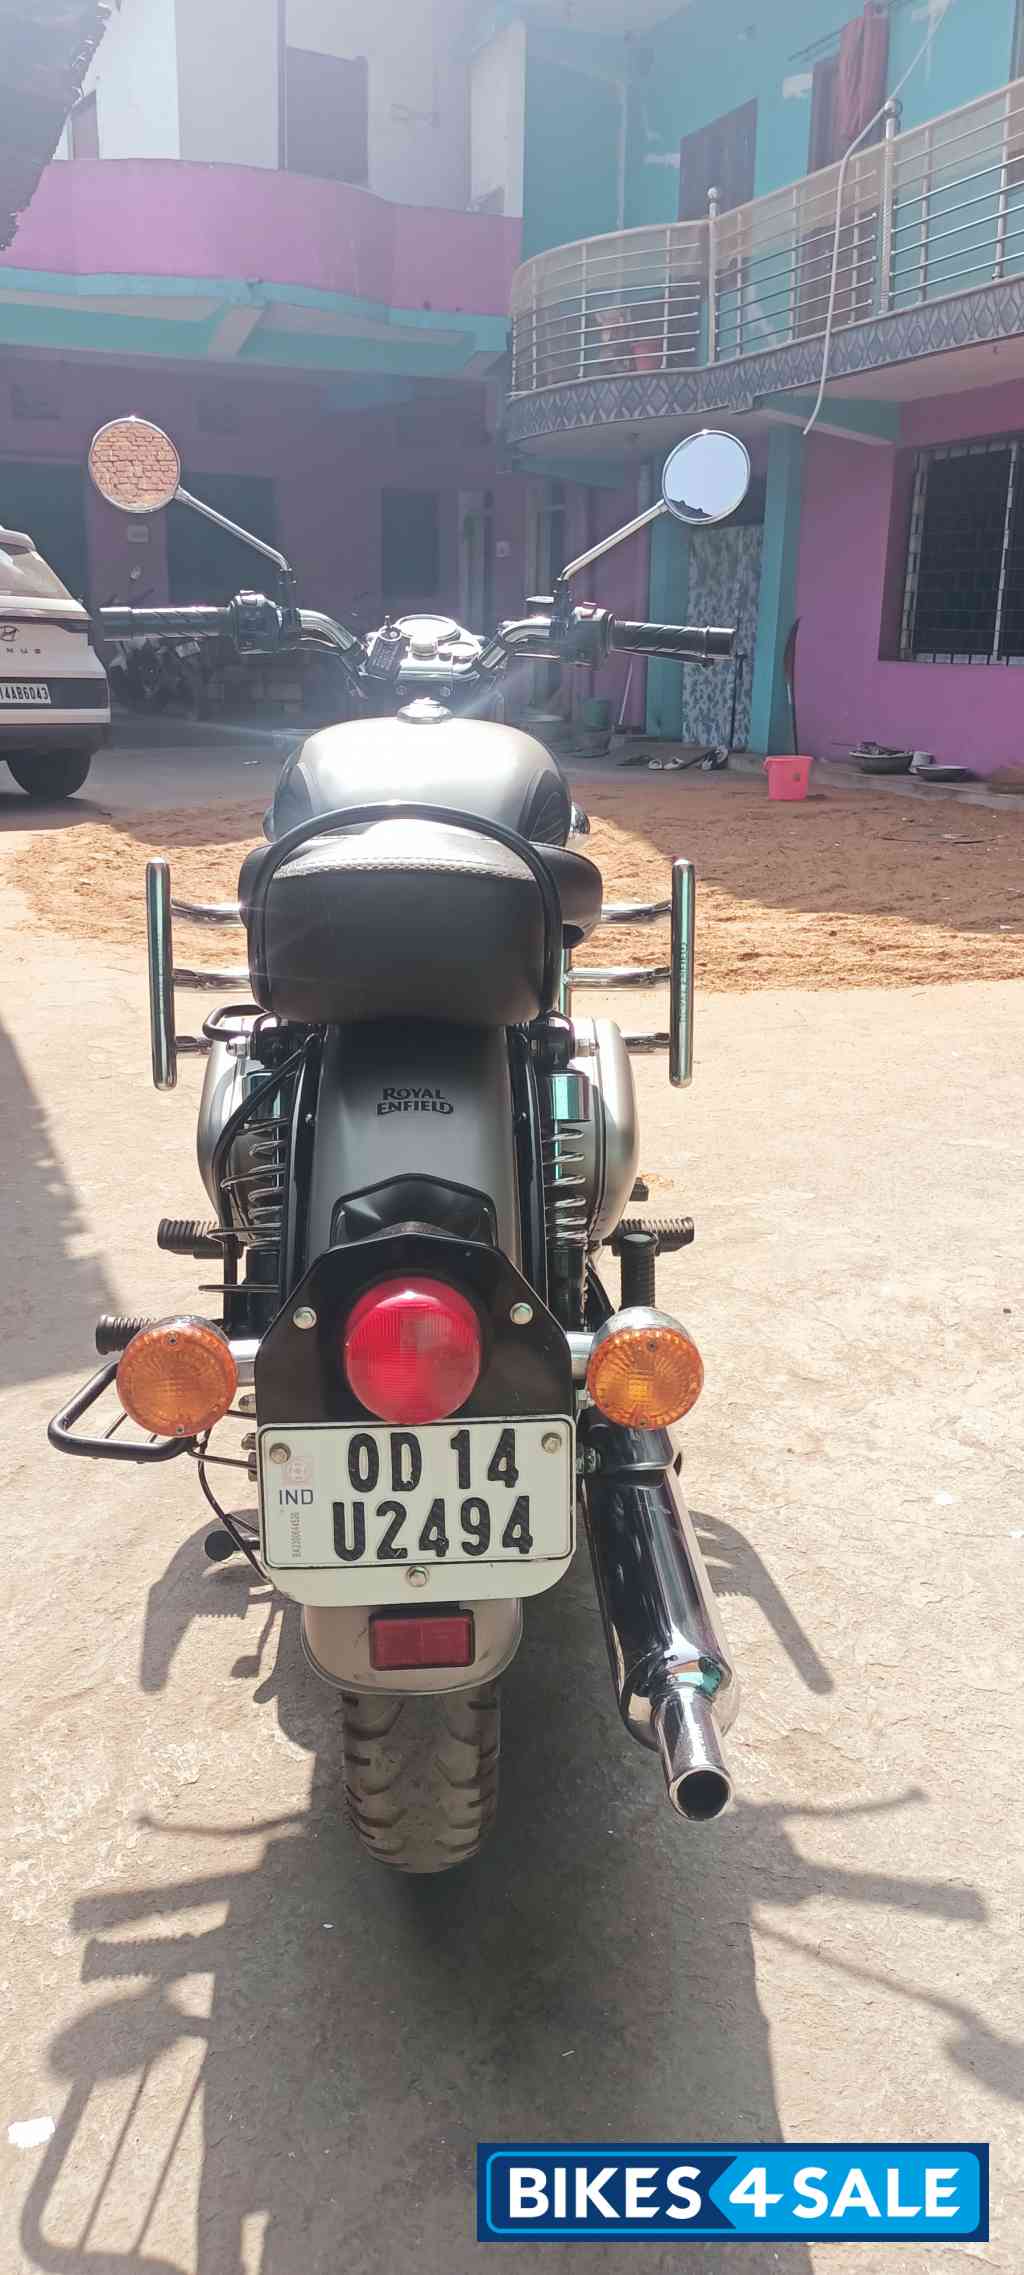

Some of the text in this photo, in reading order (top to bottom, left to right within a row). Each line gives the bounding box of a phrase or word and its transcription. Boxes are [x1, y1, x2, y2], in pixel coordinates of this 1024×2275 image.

[382, 1087, 446, 1100] ROYAL
[376, 1100, 454, 1116] ENFIELD
[347, 1428, 520, 1493] OD 14
[279, 1488, 314, 1505] IND
[332, 1495, 534, 1562] U2494
